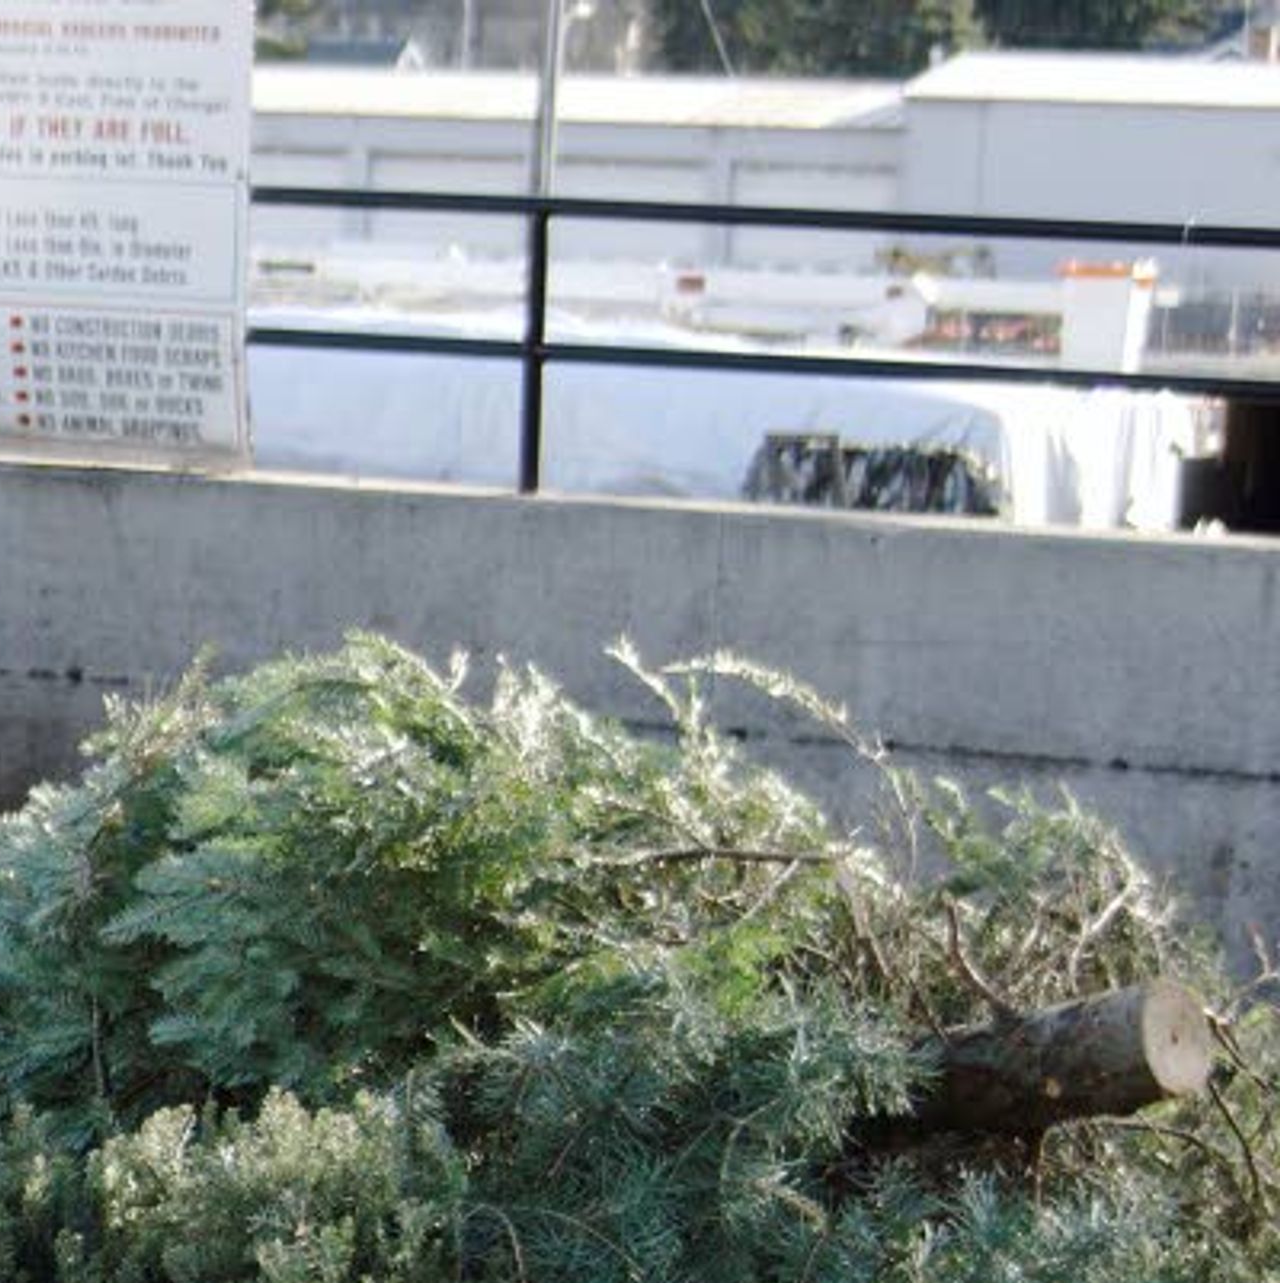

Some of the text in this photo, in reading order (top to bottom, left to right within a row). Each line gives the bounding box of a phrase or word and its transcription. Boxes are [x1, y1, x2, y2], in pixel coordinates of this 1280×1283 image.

[38, 115, 83, 140] THEY
[93, 118, 129, 142] ARE
[55, 317, 161, 341] CONSTRUCTION
